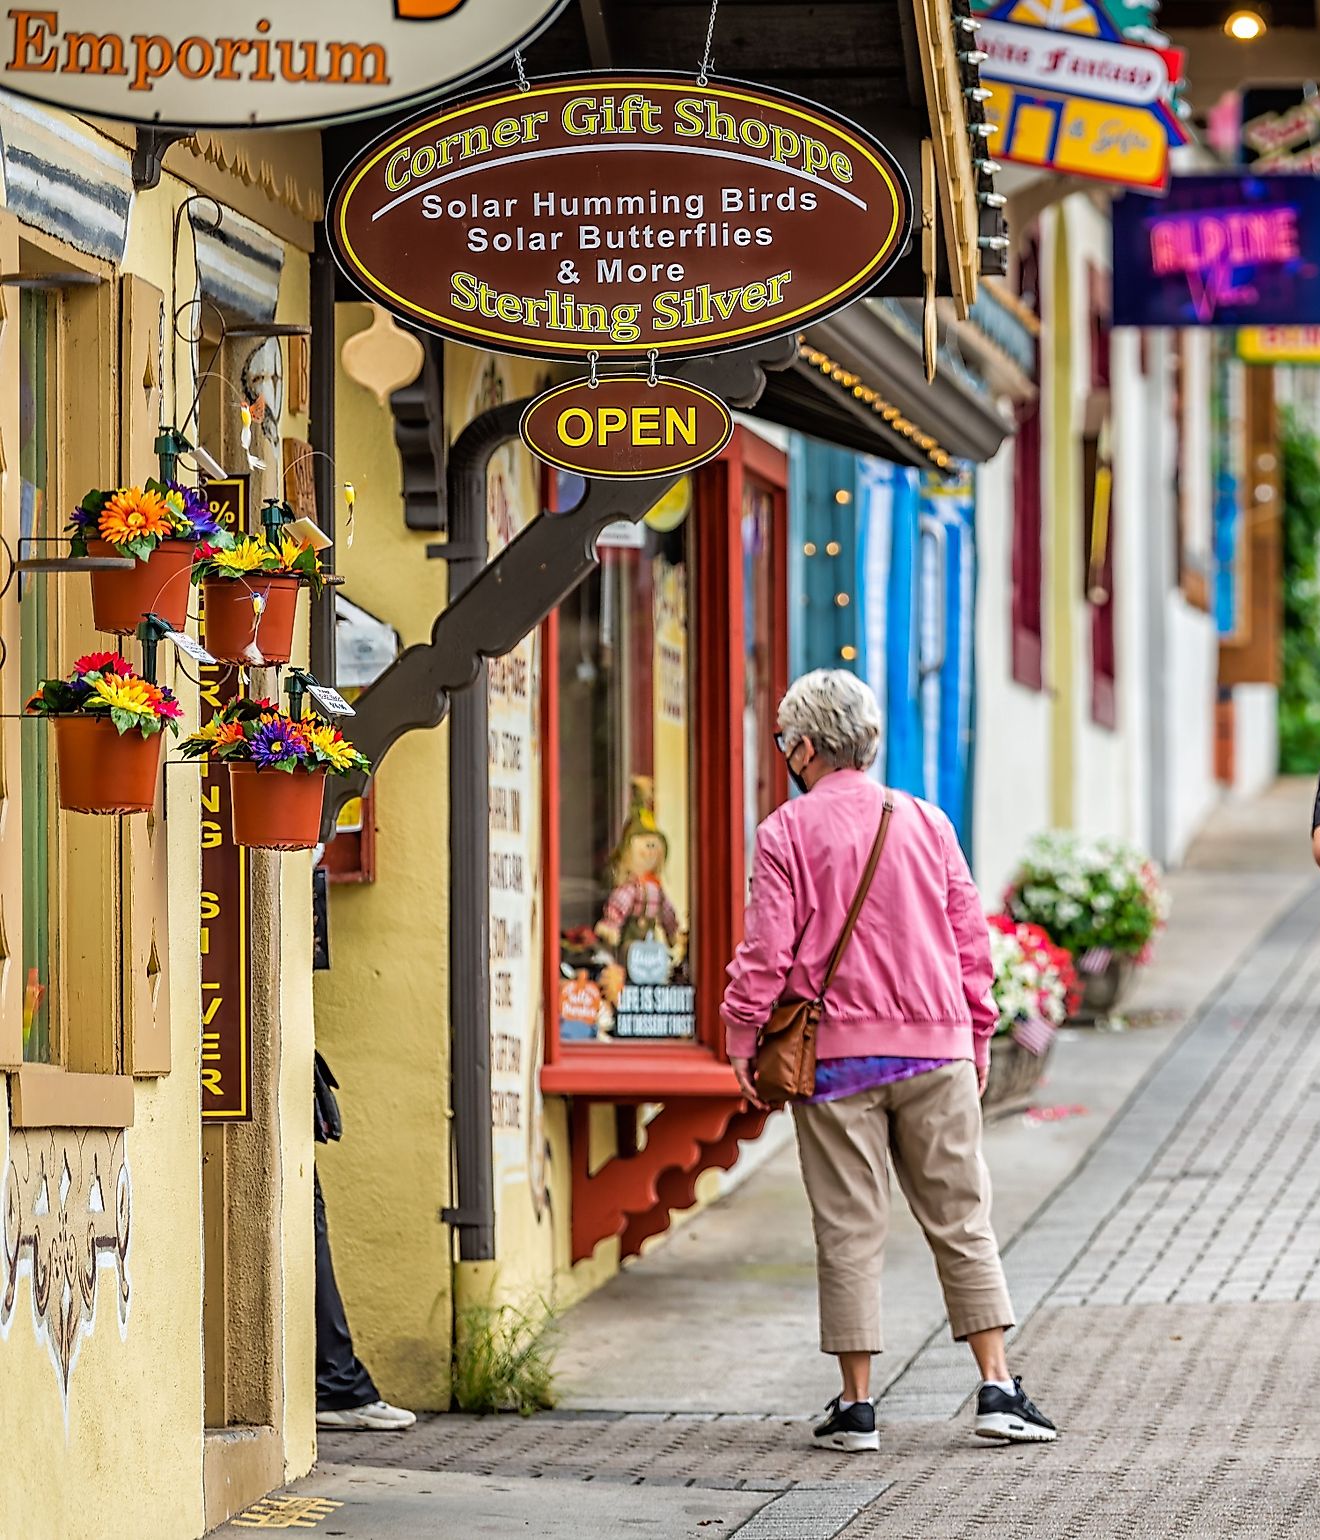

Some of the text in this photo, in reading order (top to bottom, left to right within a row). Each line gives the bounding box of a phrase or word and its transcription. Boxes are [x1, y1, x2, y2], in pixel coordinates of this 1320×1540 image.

[5, 9, 391, 91] Emporium
[384, 95, 854, 193] Corner Gift Shoppe
[421, 187, 819, 220] Solar Humming Birds
[467, 221, 774, 253] Solar Butterflies
[557, 259, 685, 284] & More
[450, 269, 792, 342] Sterling Silver
[556, 407, 698, 448] OPEN
